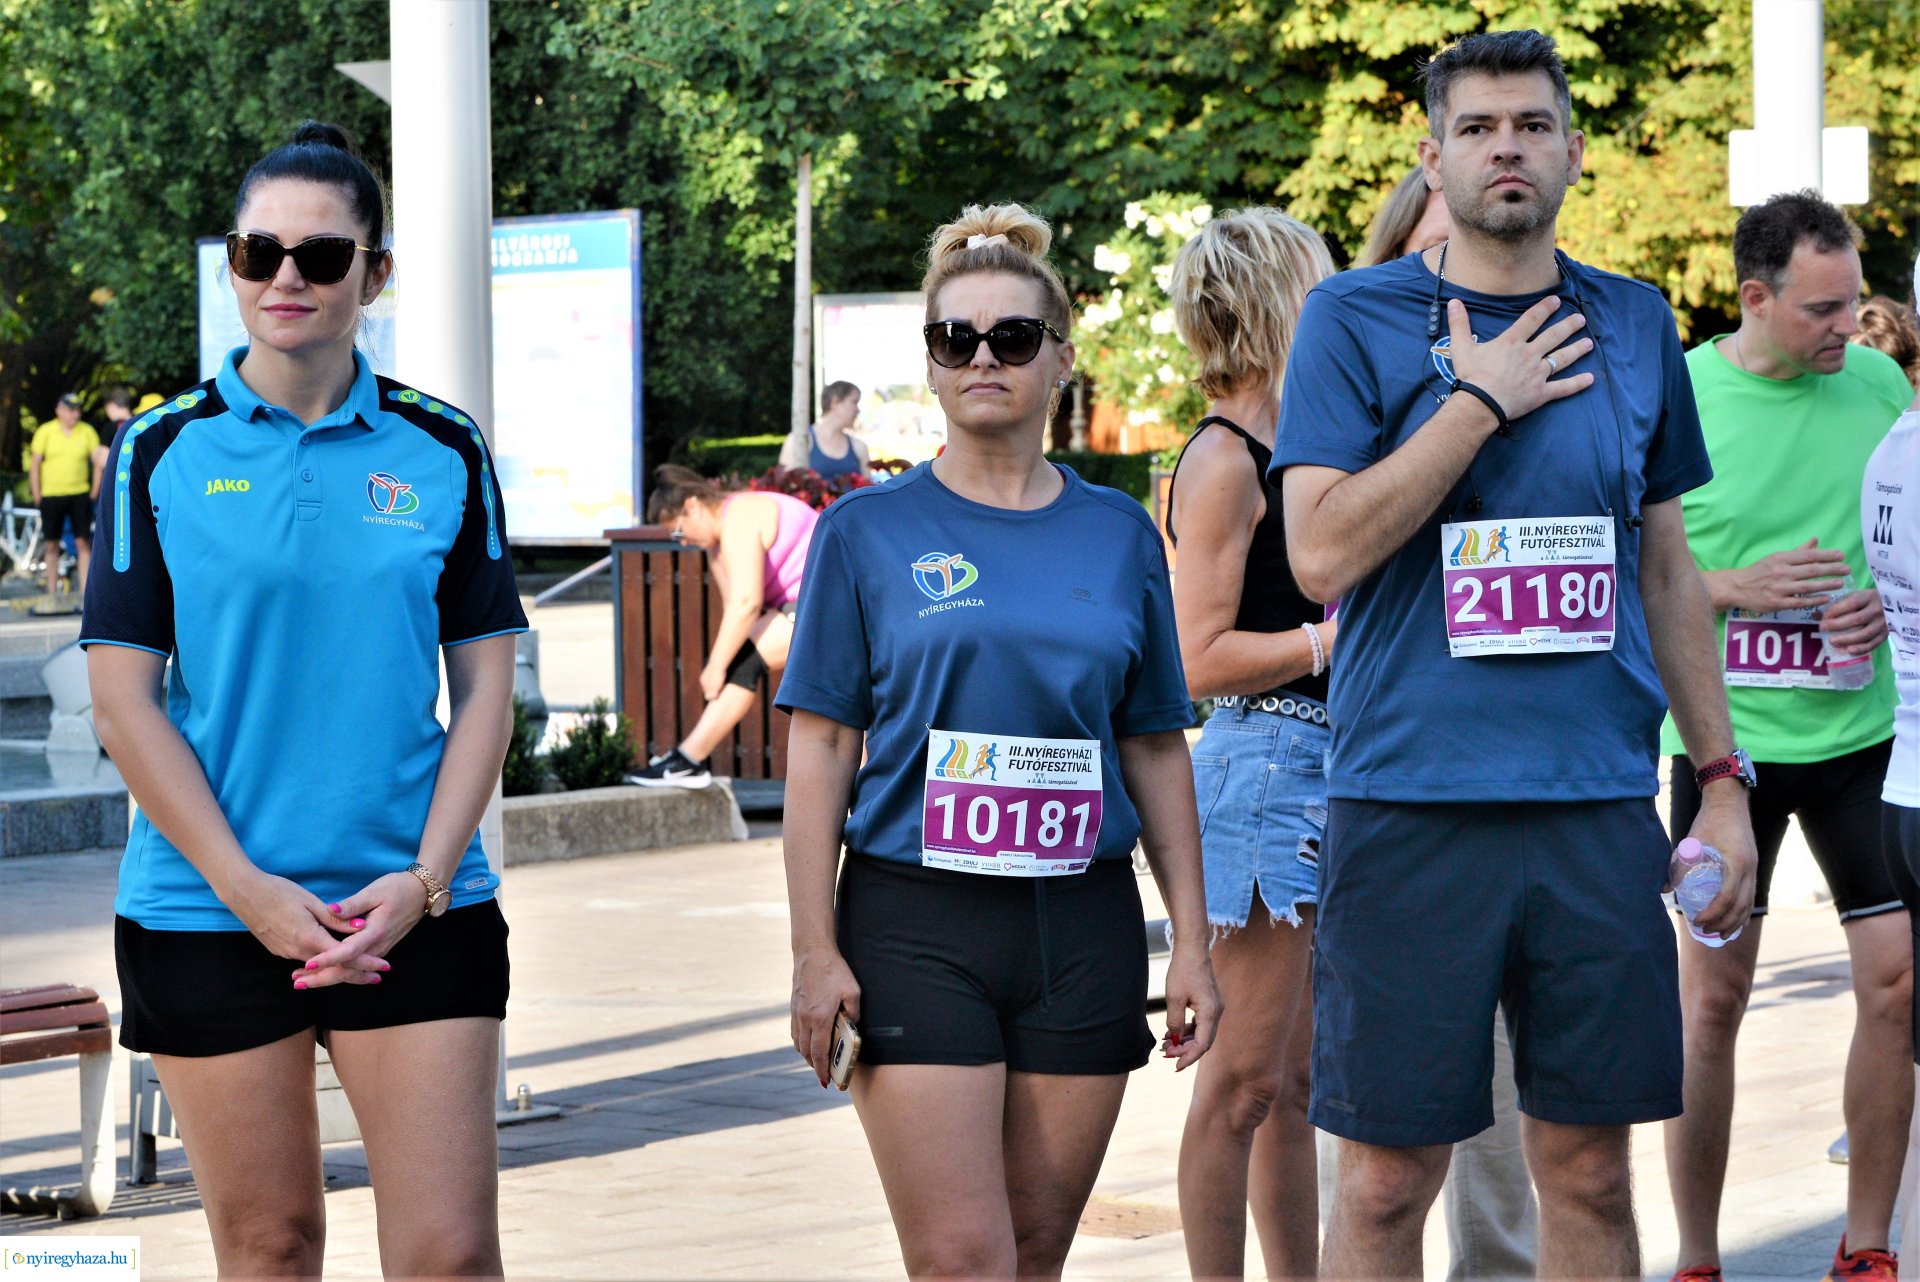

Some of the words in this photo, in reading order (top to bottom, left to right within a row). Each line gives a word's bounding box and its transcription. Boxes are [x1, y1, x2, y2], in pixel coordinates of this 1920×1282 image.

[205, 479, 250, 495] JAKO
[362, 515, 425, 532] NYÍREGYHÁZA
[1520, 535, 1606, 549] FUTÓFESZTIVÁL
[1452, 571, 1611, 623] 21180
[918, 597, 985, 618] NYÍREGYHÁZA
[1732, 629, 1828, 667] 1017
[1008, 758, 1092, 773] FUTÓFESZTIVÁL
[934, 793, 1090, 848] 10181
